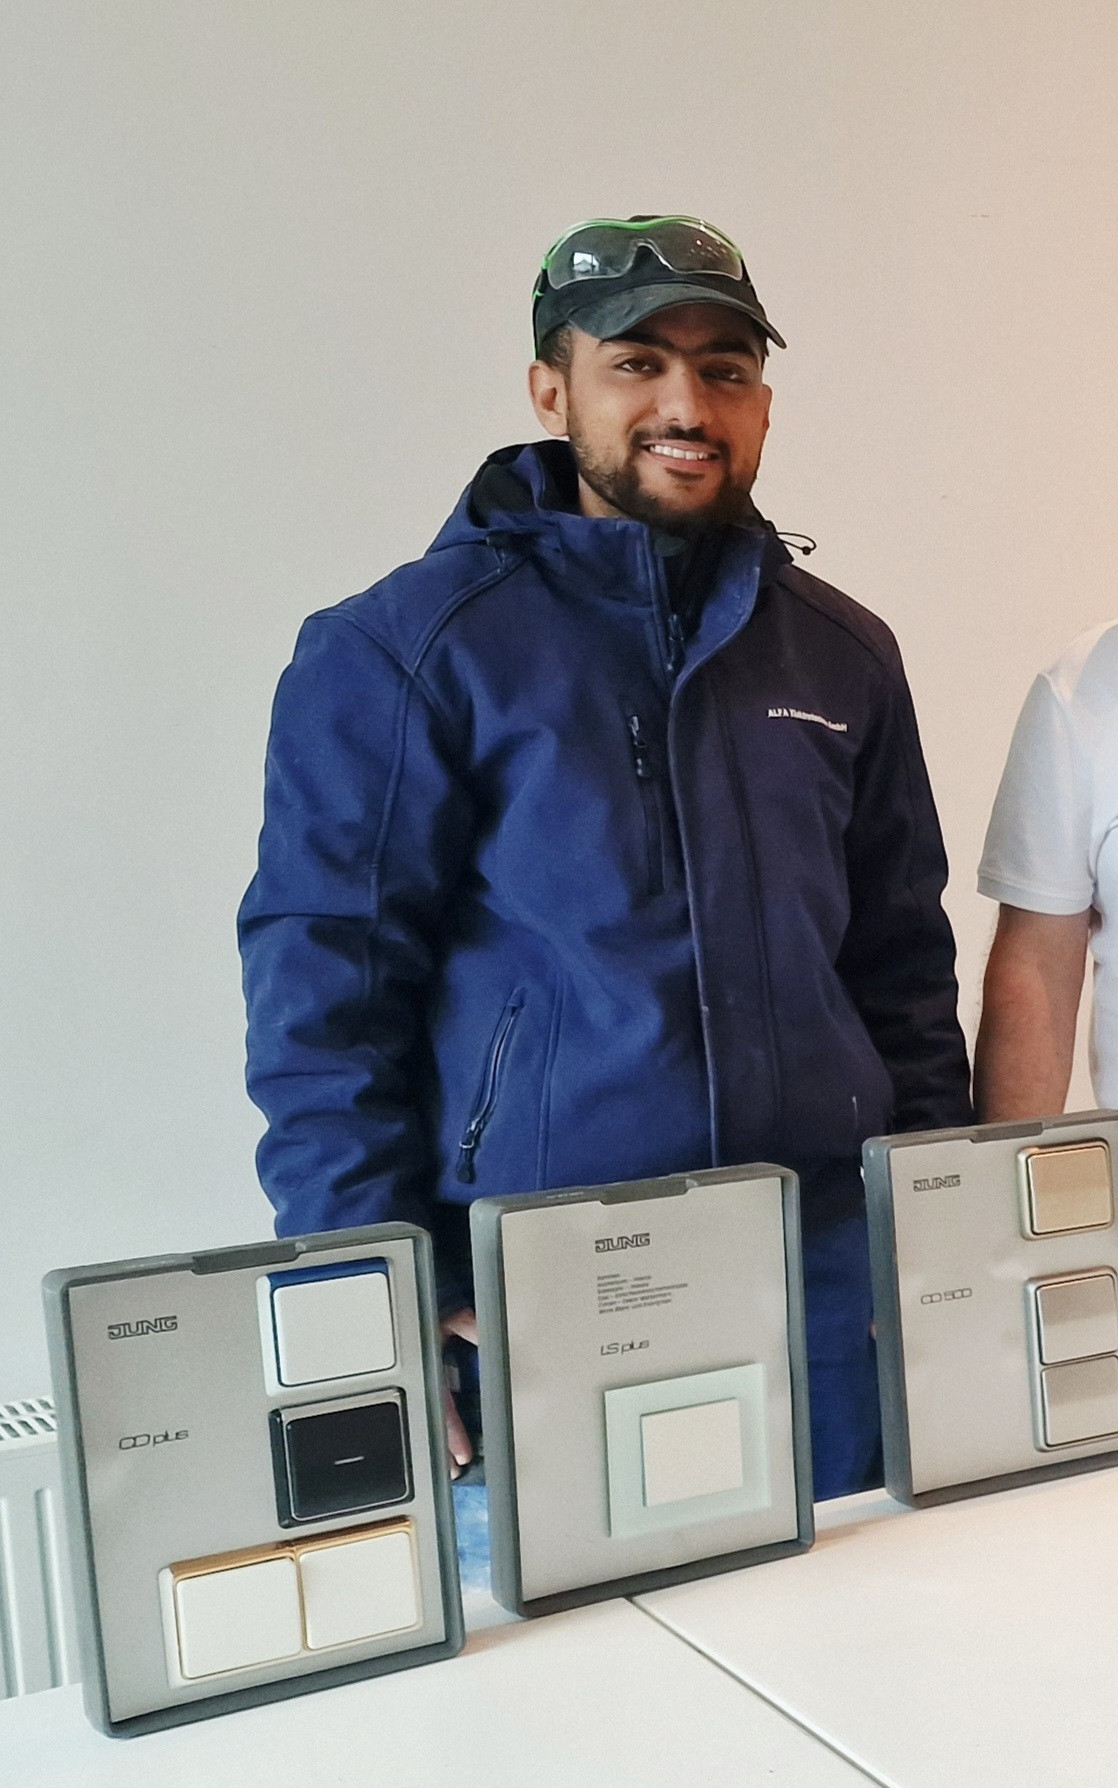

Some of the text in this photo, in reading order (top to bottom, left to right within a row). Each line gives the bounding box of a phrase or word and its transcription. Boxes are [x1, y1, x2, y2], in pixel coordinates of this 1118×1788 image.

[913, 1174, 961, 1192] JUNG
[595, 1232, 651, 1253] JUNG
[107, 1315, 178, 1340] JUNG
[601, 1340, 650, 1356] LS plus
[153, 1430, 189, 1447] plus
